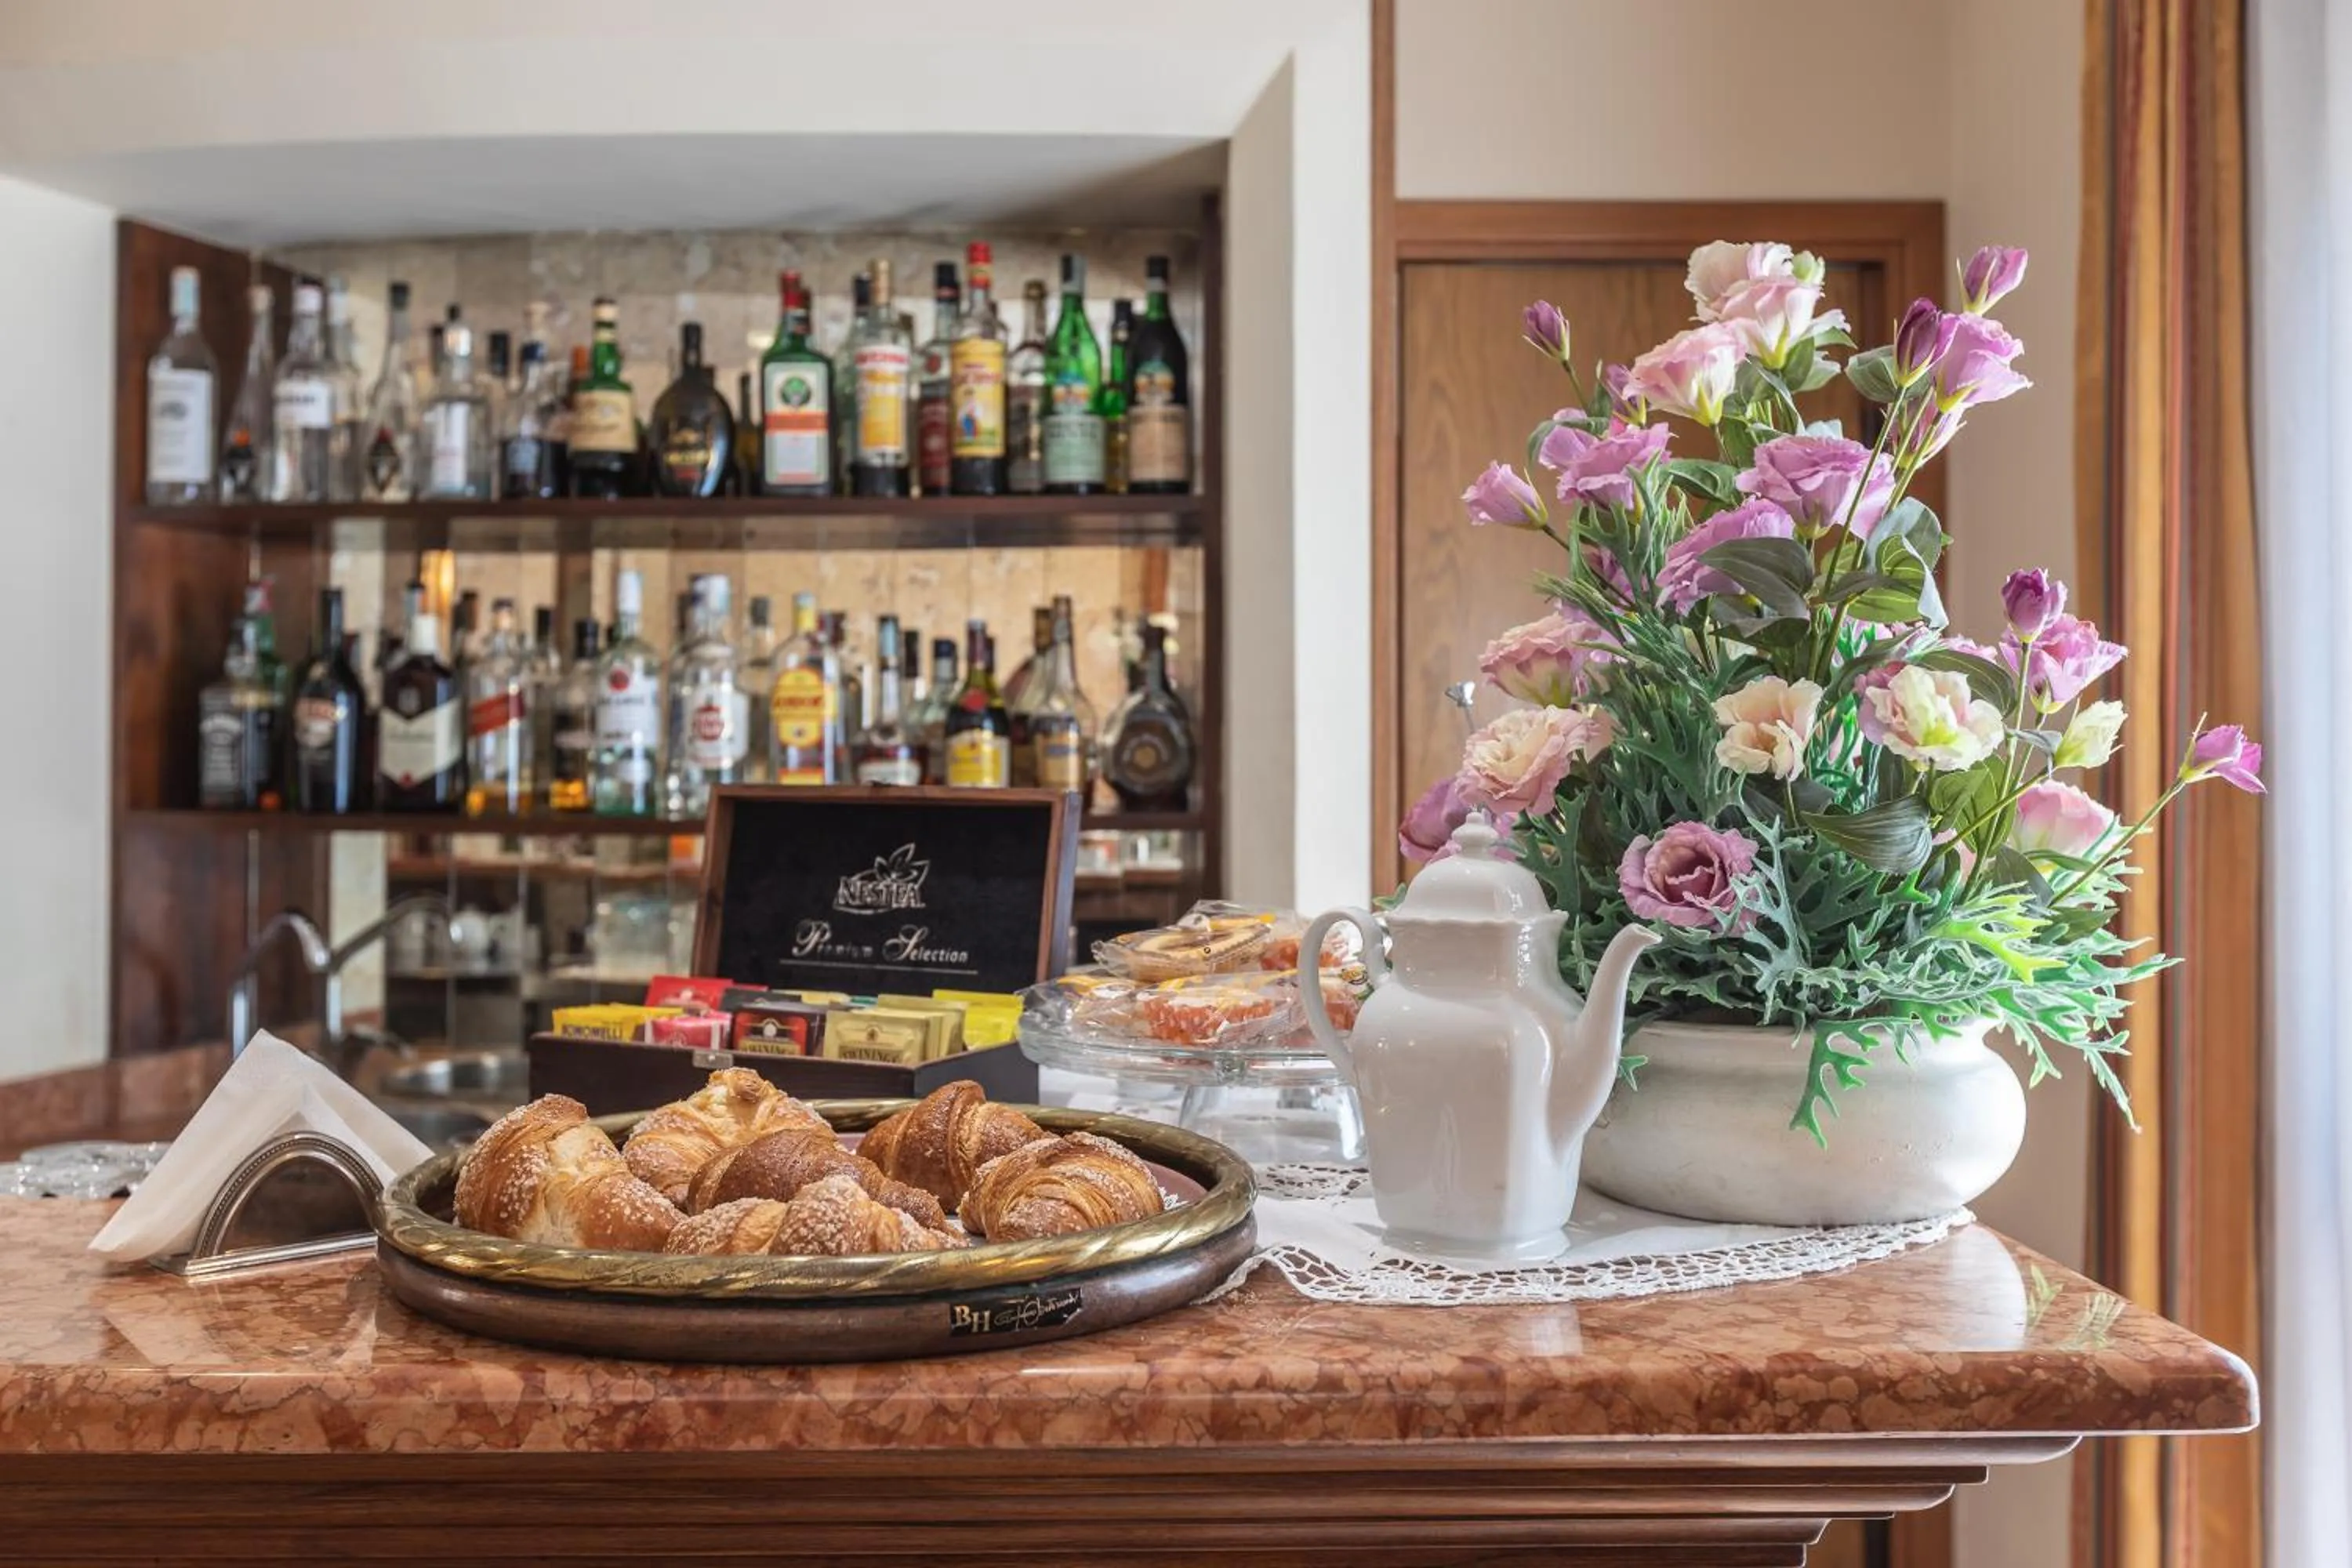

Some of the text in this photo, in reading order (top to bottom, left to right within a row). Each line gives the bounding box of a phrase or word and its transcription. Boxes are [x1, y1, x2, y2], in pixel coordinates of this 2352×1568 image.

[838, 877, 926, 908] NESTEA
[792, 919, 968, 963] Premium Selection
